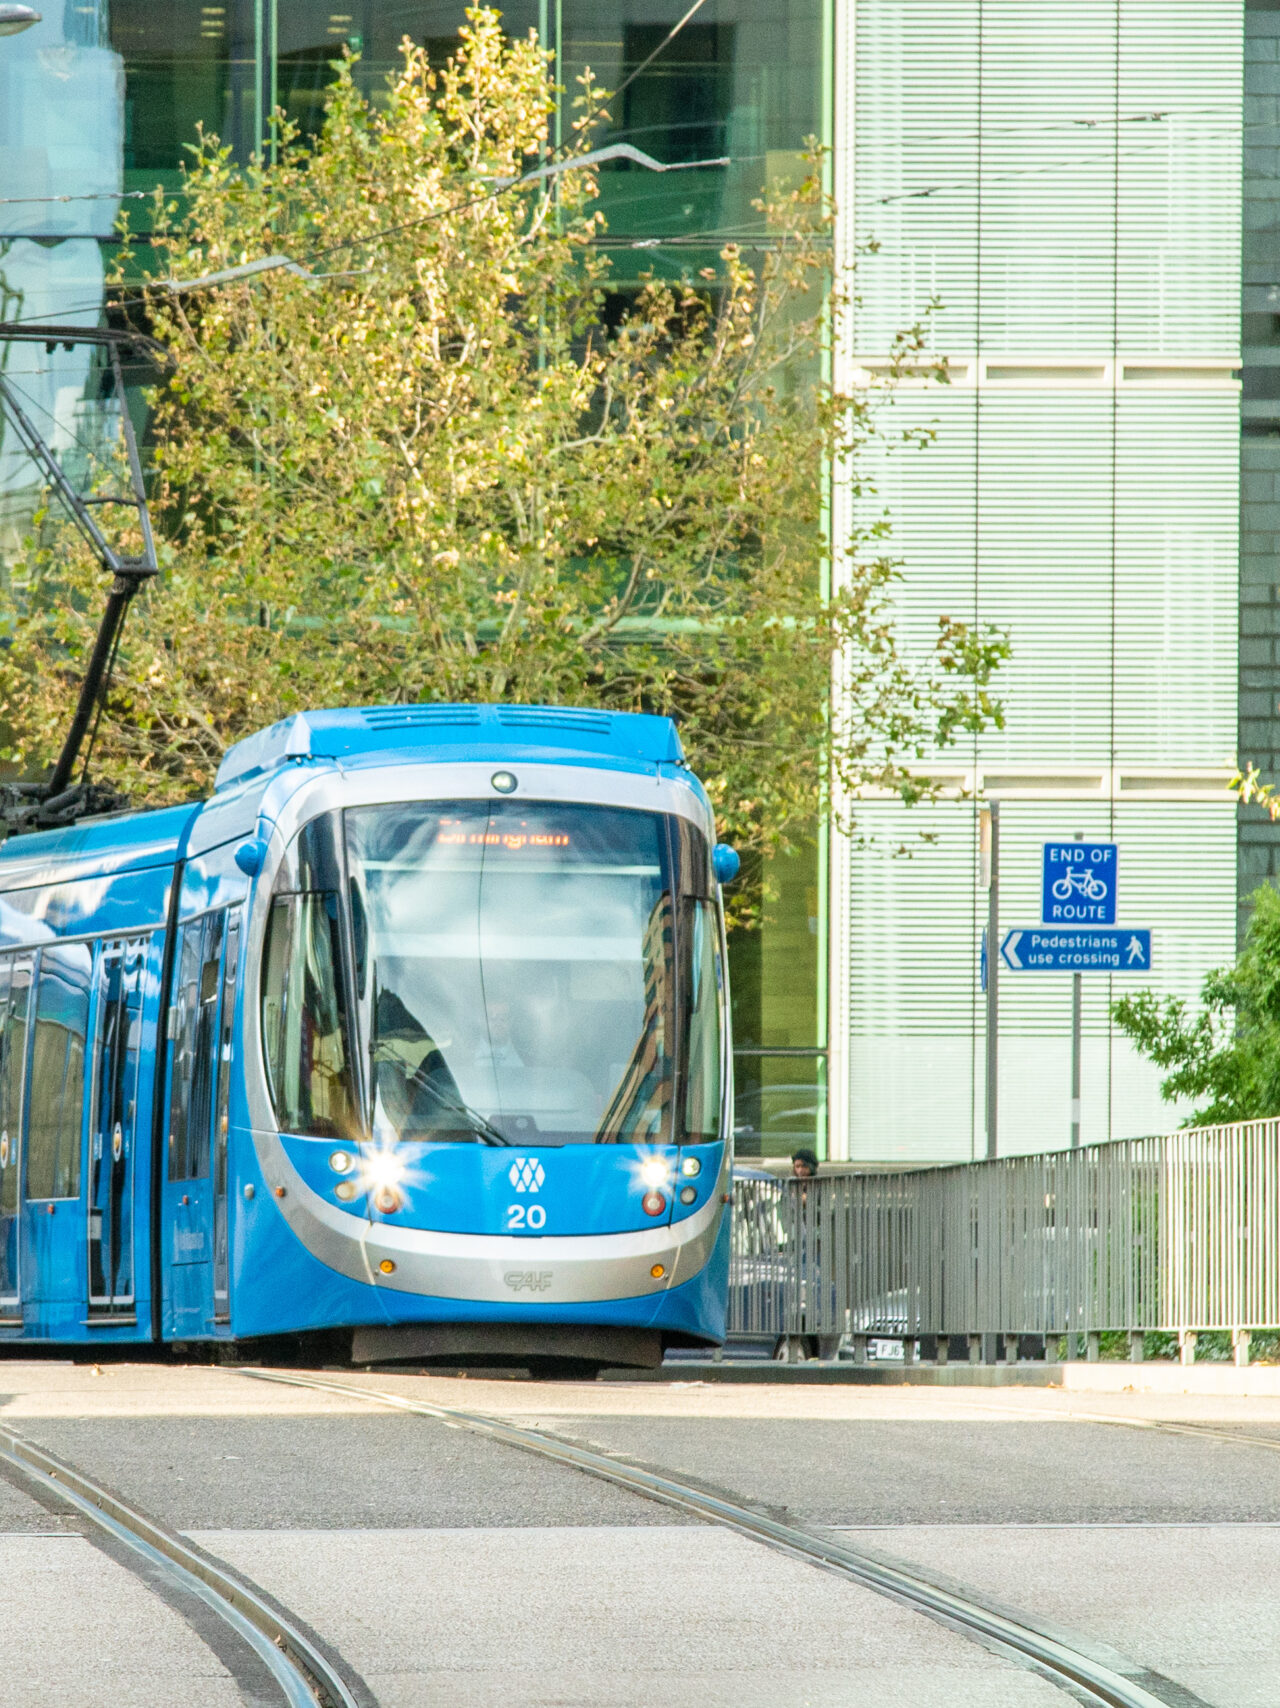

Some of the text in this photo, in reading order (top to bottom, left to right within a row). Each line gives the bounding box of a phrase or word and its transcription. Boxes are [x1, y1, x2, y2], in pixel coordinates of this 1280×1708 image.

[1050, 848, 1113, 863] END OF
[1052, 904, 1106, 919] ROUTE
[1031, 934, 1118, 948] Pedestrians
[1028, 951, 1120, 966] use crossing
[507, 1204, 547, 1229] 20
